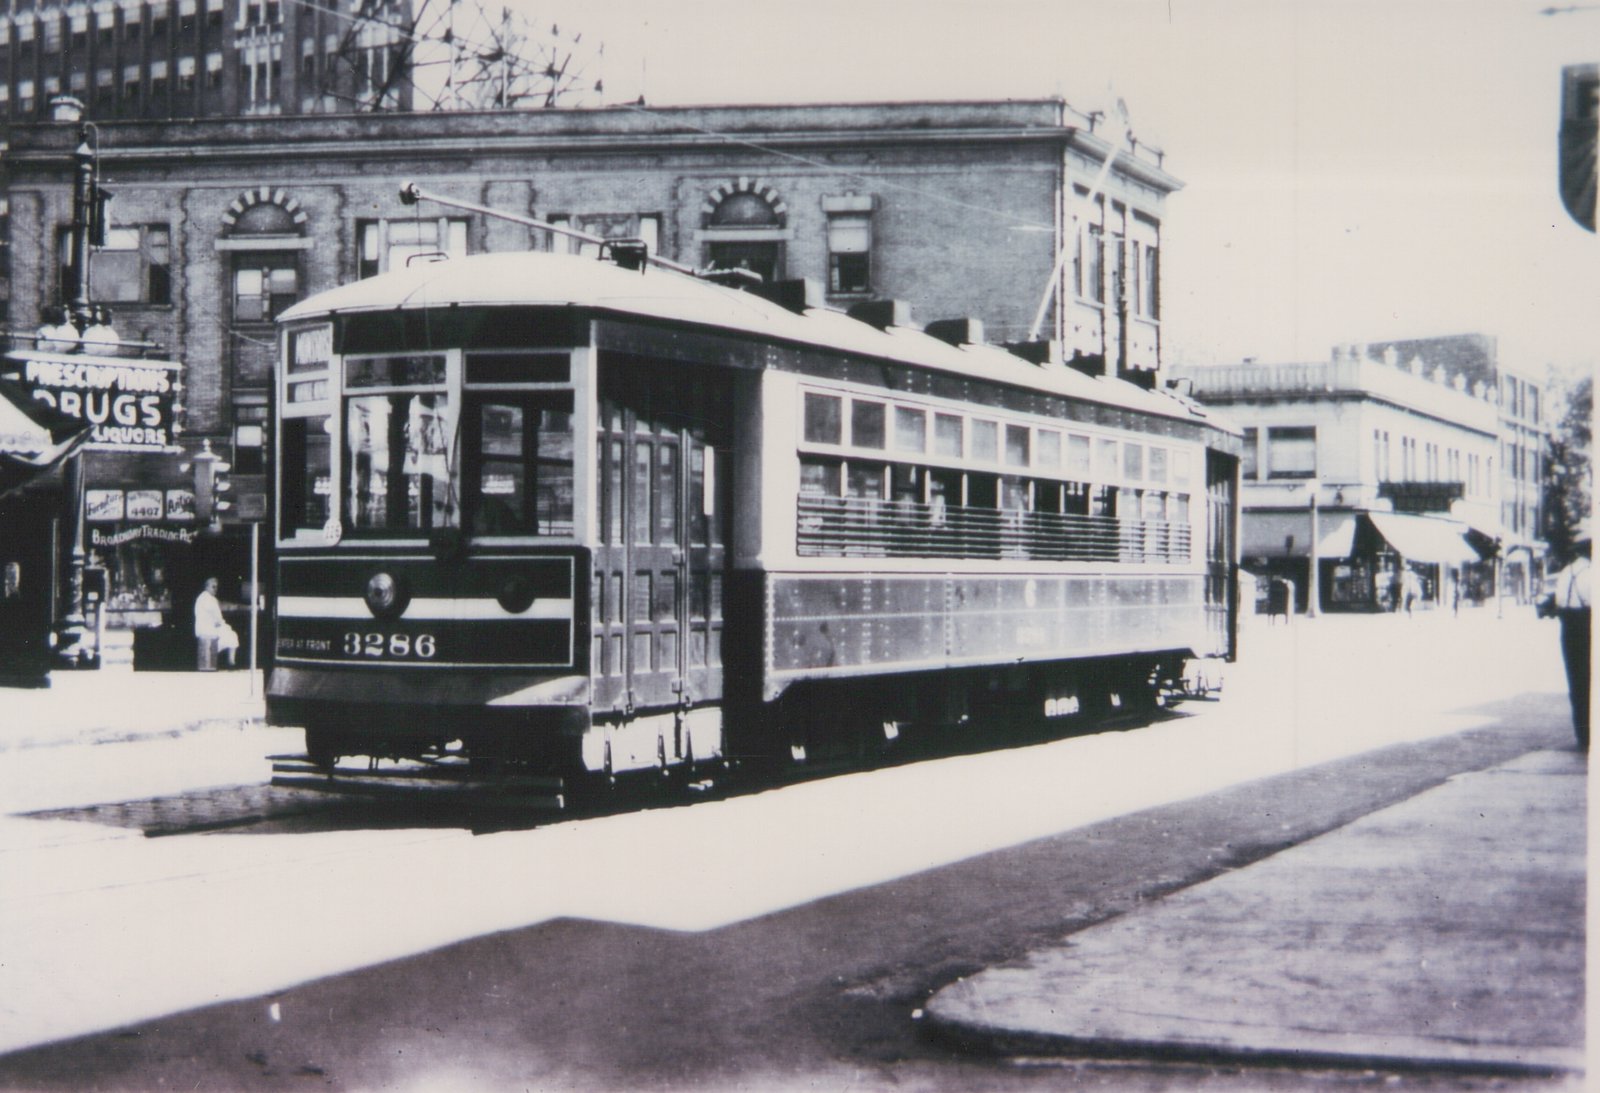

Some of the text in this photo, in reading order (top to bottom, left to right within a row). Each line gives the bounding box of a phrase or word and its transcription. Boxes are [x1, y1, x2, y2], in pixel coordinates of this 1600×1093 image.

[26, 361, 169, 393] PRESCRIPTIONS
[92, 427, 167, 445] LIQUORS
[306, 639, 331, 650] FRONT
[344, 632, 436, 658] 3286
